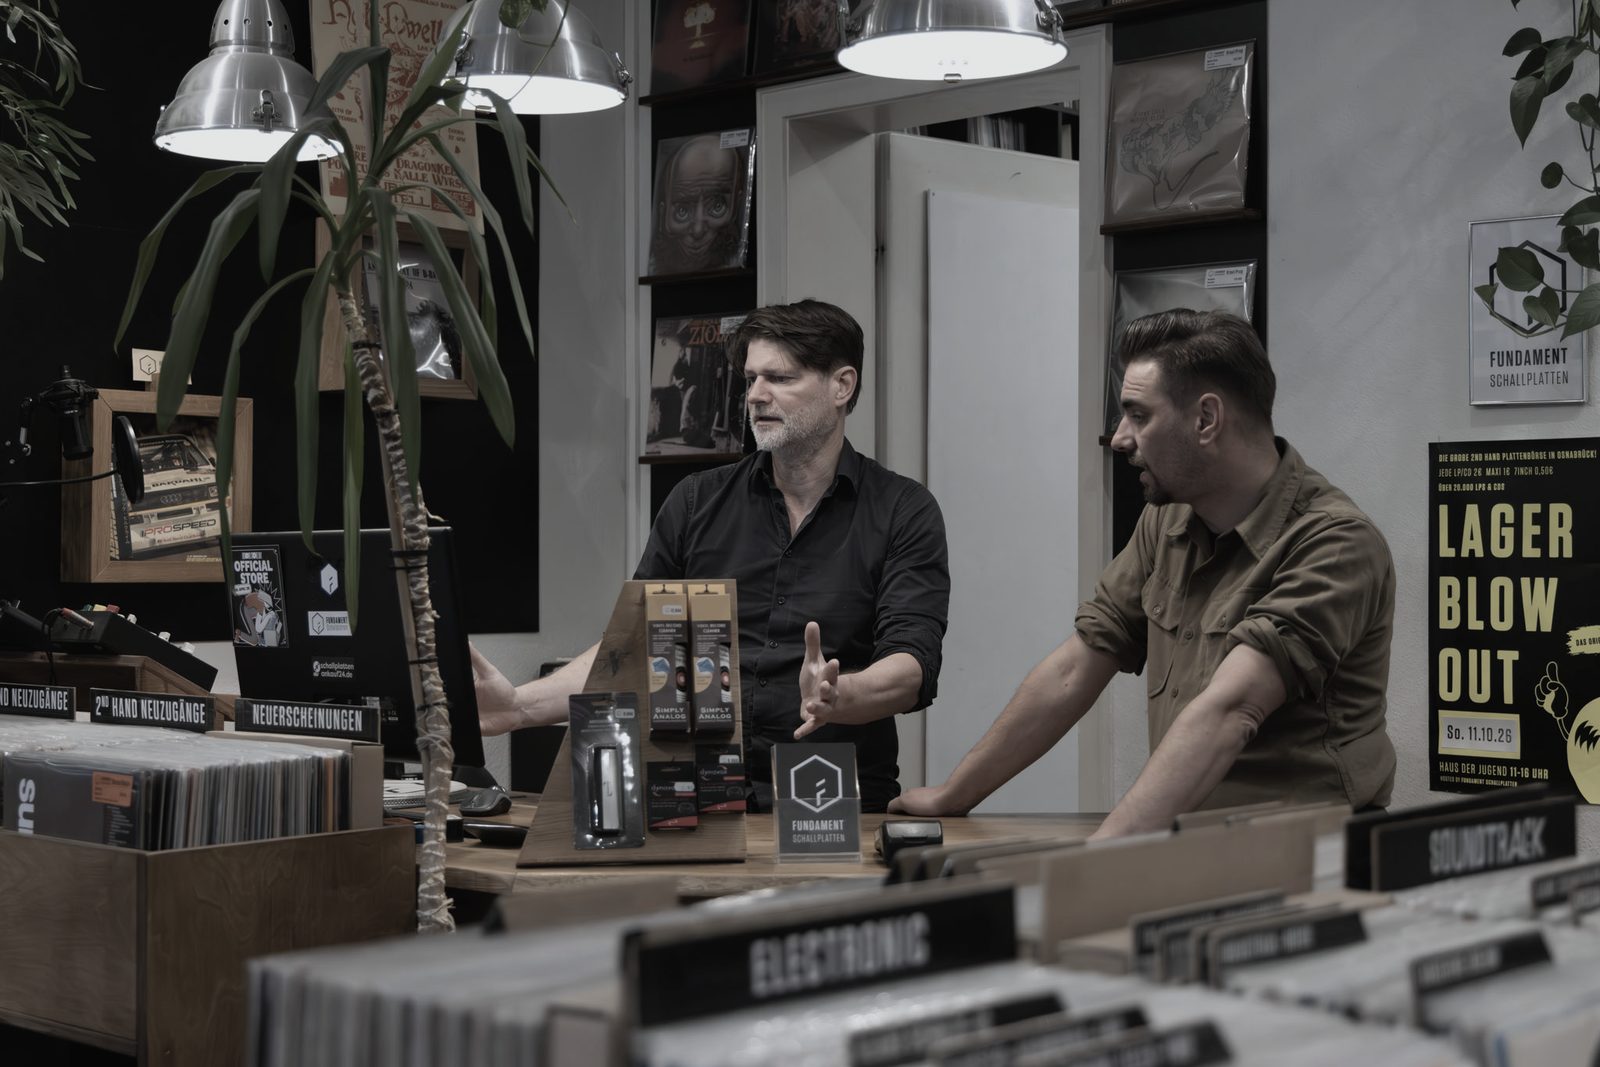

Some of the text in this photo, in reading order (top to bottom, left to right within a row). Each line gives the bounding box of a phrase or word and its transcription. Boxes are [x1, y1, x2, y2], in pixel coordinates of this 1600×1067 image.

[1489, 347, 1568, 368] FUNDAMENT
[1489, 371, 1569, 388] SCHALLPLATTEN
[1438, 453, 1449, 462] DIE
[1471, 452, 1483, 462] 2ND
[1484, 452, 1500, 461] HAND
[1548, 451, 1555, 459] IN
[1556, 448, 1598, 459] OSNABRÜCK!
[1438, 468, 1453, 477] JEDE
[1454, 467, 1472, 477] LP/CD
[1485, 467, 1501, 476] MAXI
[1513, 466, 1533, 476] 7INCH
[1438, 502, 1573, 559] LAGER
[234, 560, 274, 572] OFFICIAL
[240, 572, 270, 584] STORE
[1438, 576, 1559, 632] BLOW
[1575, 638, 1587, 646] DAS
[1438, 647, 1520, 705] OUT
[11, 687, 69, 711] NEUZUGÄNGE
[112, 697, 138, 719] HAND
[140, 698, 206, 725] NEUZUGÄNGE
[252, 703, 363, 732] NEUERSCHEINUNGEN
[655, 706, 685, 715] SIMPLY
[700, 706, 730, 715] SIMPLY
[1447, 724, 1513, 744] So. 11.10.26
[1439, 761, 1550, 780] HAUS DER JUGEND 11-16 UHR
[792, 819, 845, 831] FUNDAMENT
[792, 833, 846, 843] SCHALLPLATTEN
[1428, 815, 1549, 878] SOUNDTRACK
